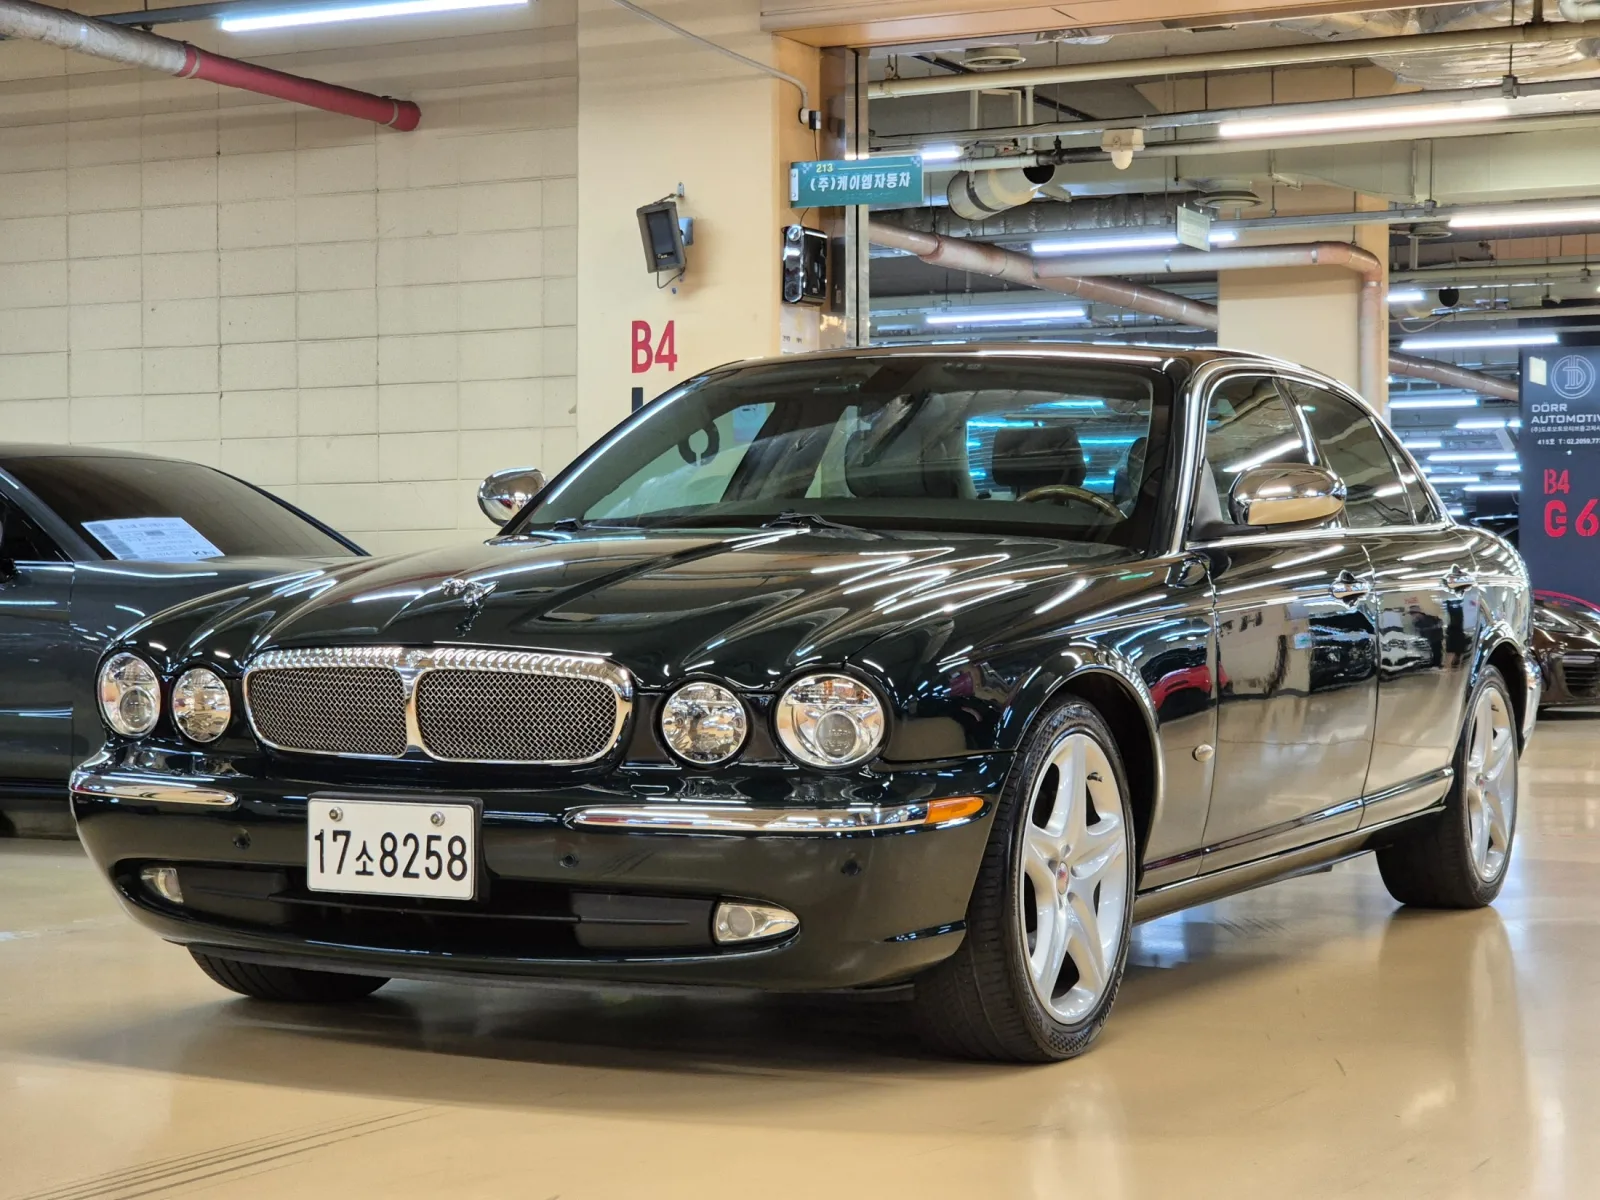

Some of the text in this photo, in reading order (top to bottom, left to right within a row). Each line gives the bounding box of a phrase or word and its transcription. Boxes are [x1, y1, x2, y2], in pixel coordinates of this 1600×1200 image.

[816, 163, 833, 173] 213
[810, 172, 911, 193] (주)케이엠자동차
[631, 320, 678, 374] B4
[1531, 402, 1567, 412] DÖRR
[1544, 468, 1570, 495] B4
[313, 828, 468, 882] 17소8258
